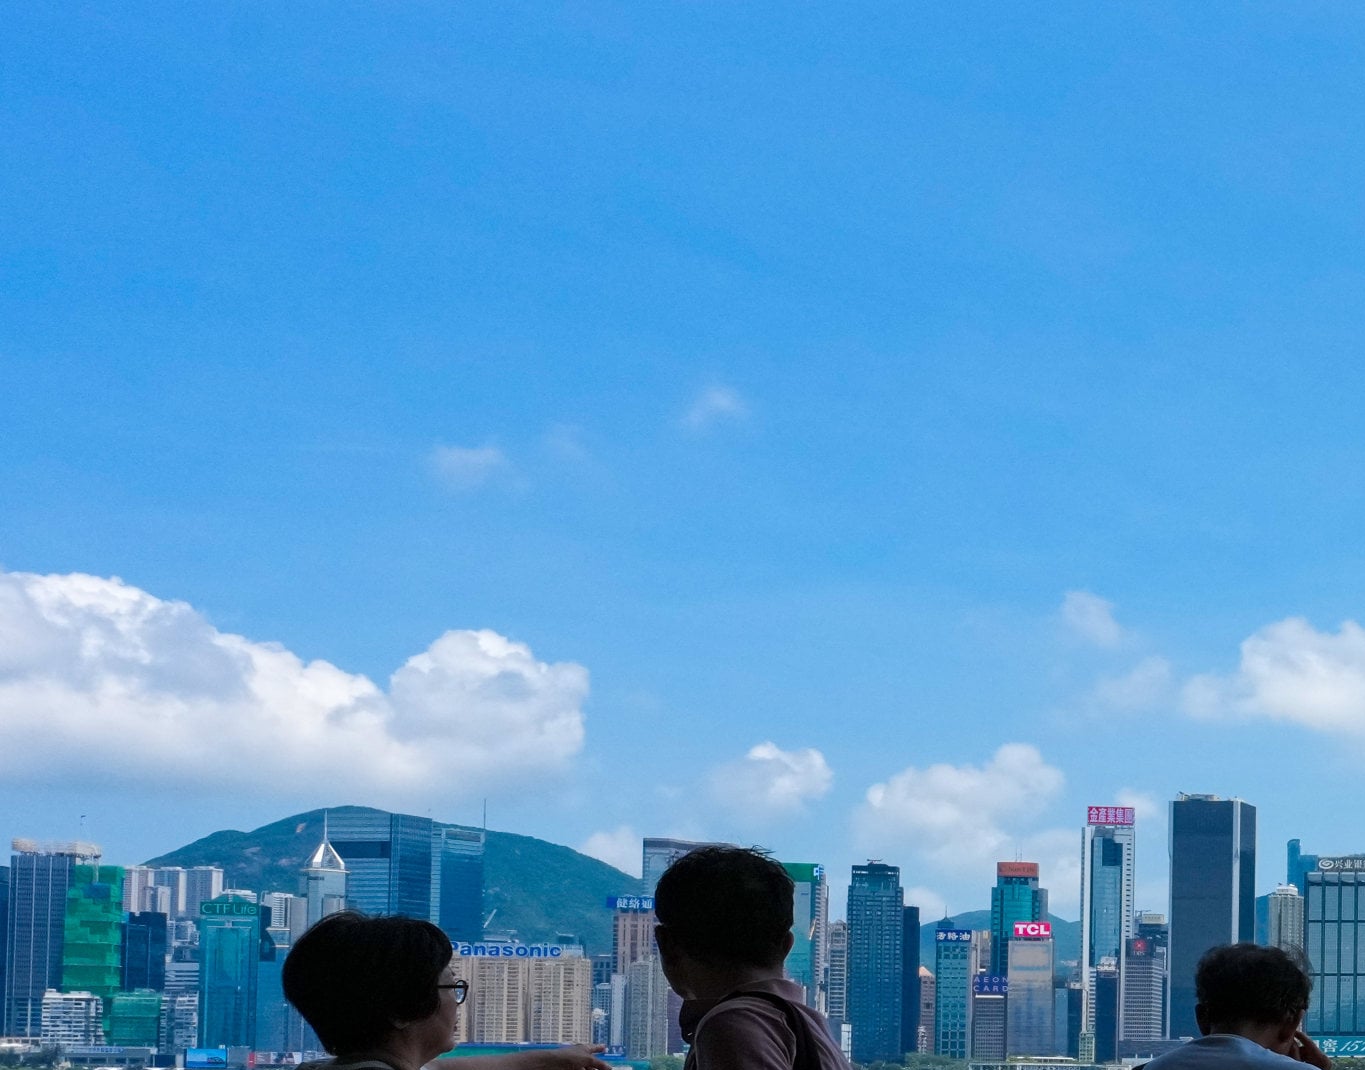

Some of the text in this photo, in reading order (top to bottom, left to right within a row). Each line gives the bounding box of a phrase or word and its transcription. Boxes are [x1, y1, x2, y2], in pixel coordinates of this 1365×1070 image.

[202, 903, 257, 915] CTF Life
[1014, 923, 1050, 935] TCL
